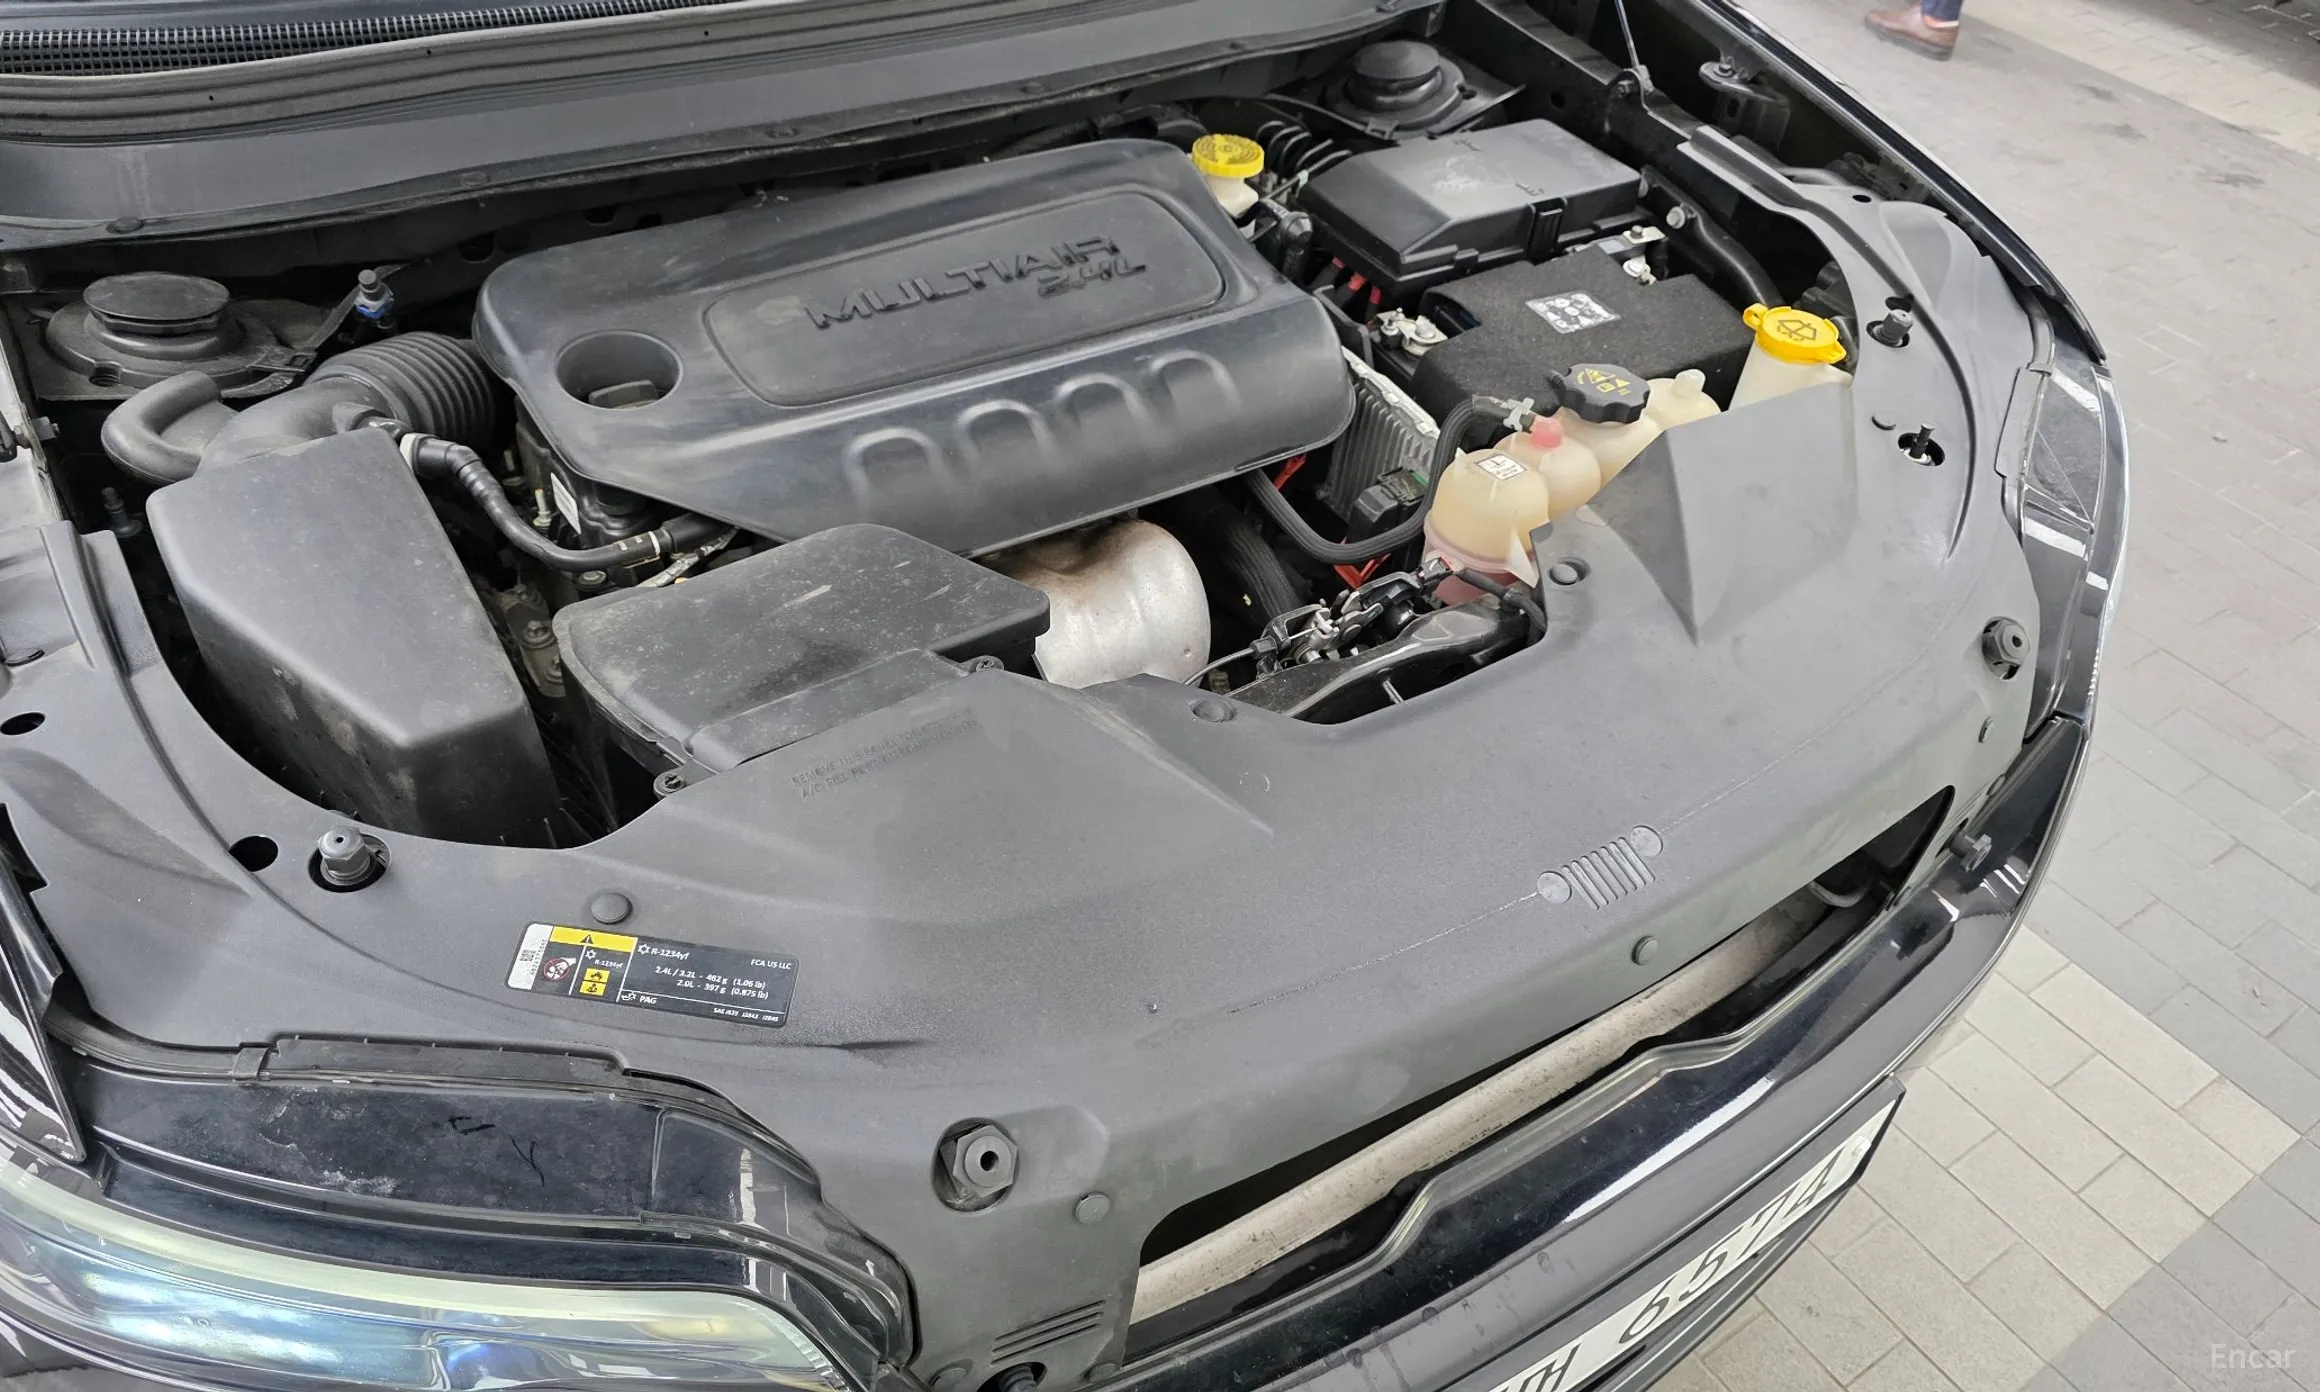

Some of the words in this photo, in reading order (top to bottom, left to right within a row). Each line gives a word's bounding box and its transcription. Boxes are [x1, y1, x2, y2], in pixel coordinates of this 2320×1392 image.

[805, 234, 1119, 330] MULTIAIR
[1037, 256, 1146, 298] 2.4L
[650, 948, 690, 961] R-1234yf
[751, 959, 765, 967] FCA
[767, 960, 778, 968] US
[779, 961, 792, 970] LLC
[655, 965, 672, 975] 2.4L
[672, 968, 679, 977] /
[677, 979, 695, 989] 2.0L
[640, 995, 657, 1005] PAG
[1618, 1140, 1846, 1346] 6574
